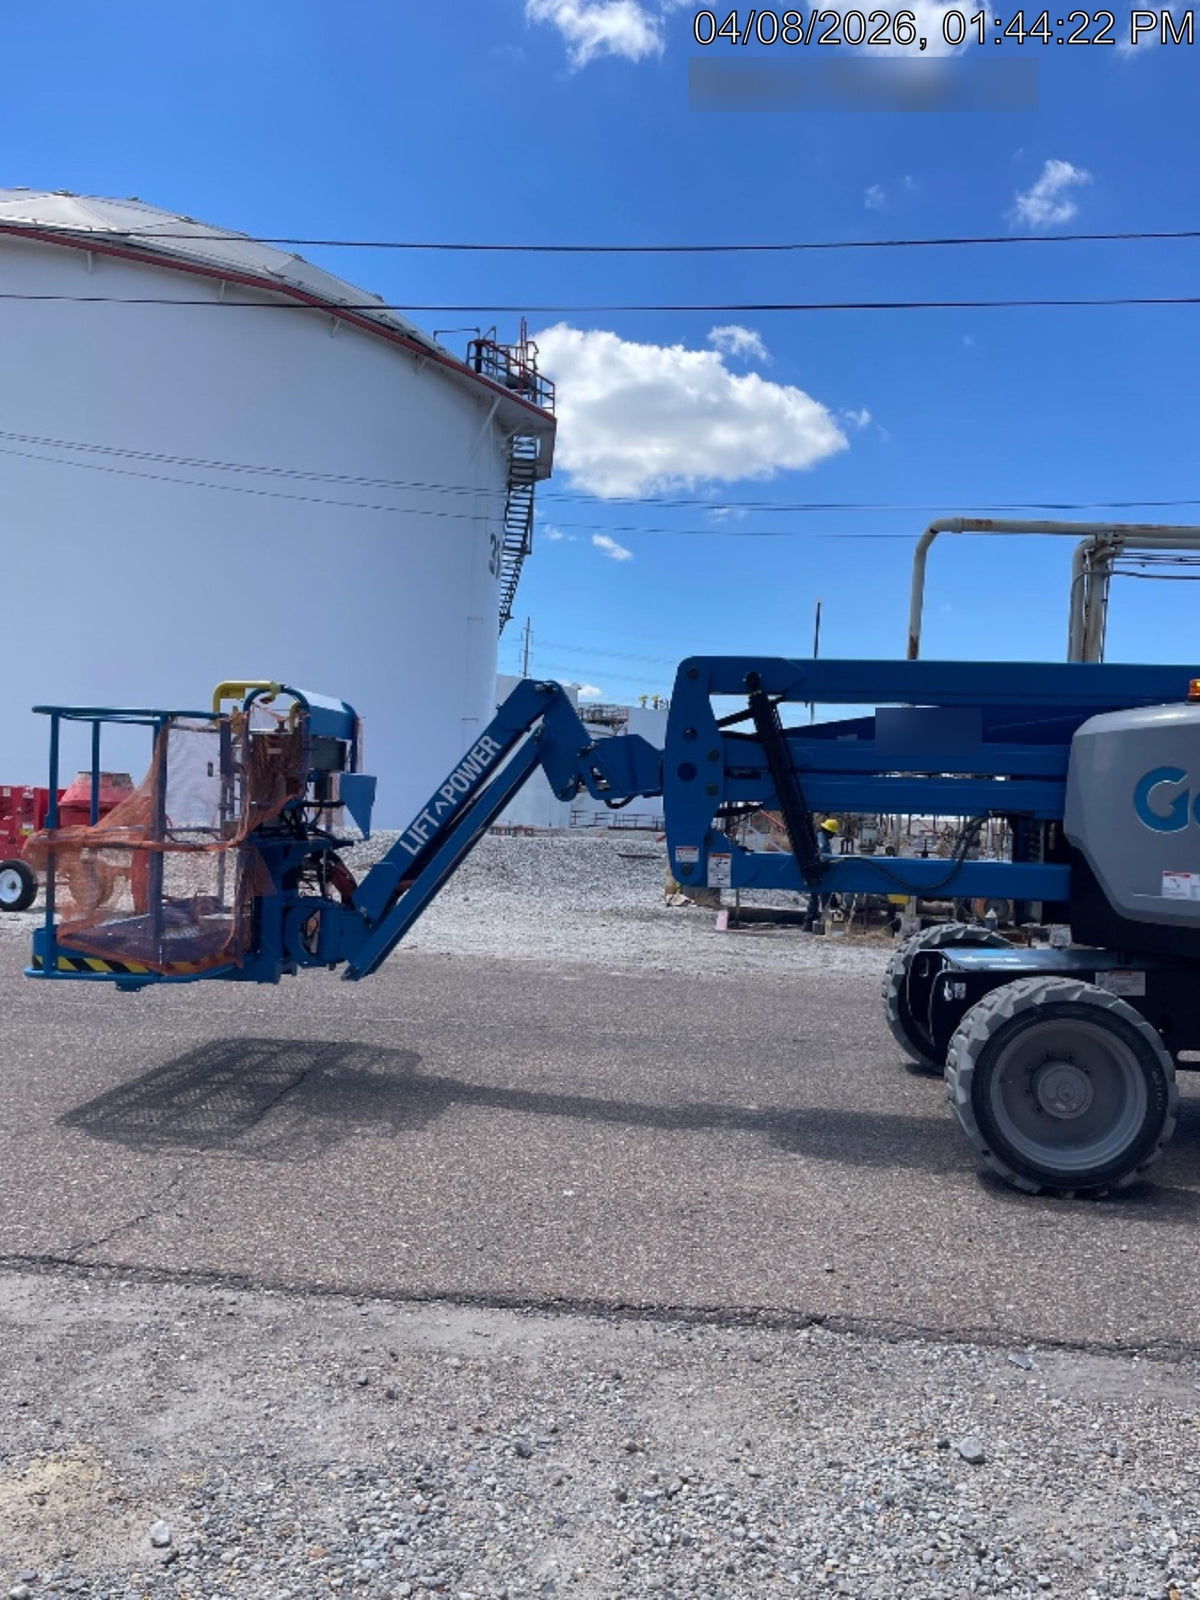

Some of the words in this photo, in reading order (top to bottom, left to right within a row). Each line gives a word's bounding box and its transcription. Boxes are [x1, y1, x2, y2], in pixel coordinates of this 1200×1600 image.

[400, 808, 440, 856] LIFT
[439, 735, 502, 806] POWER
[1133, 766, 1200, 834] G
